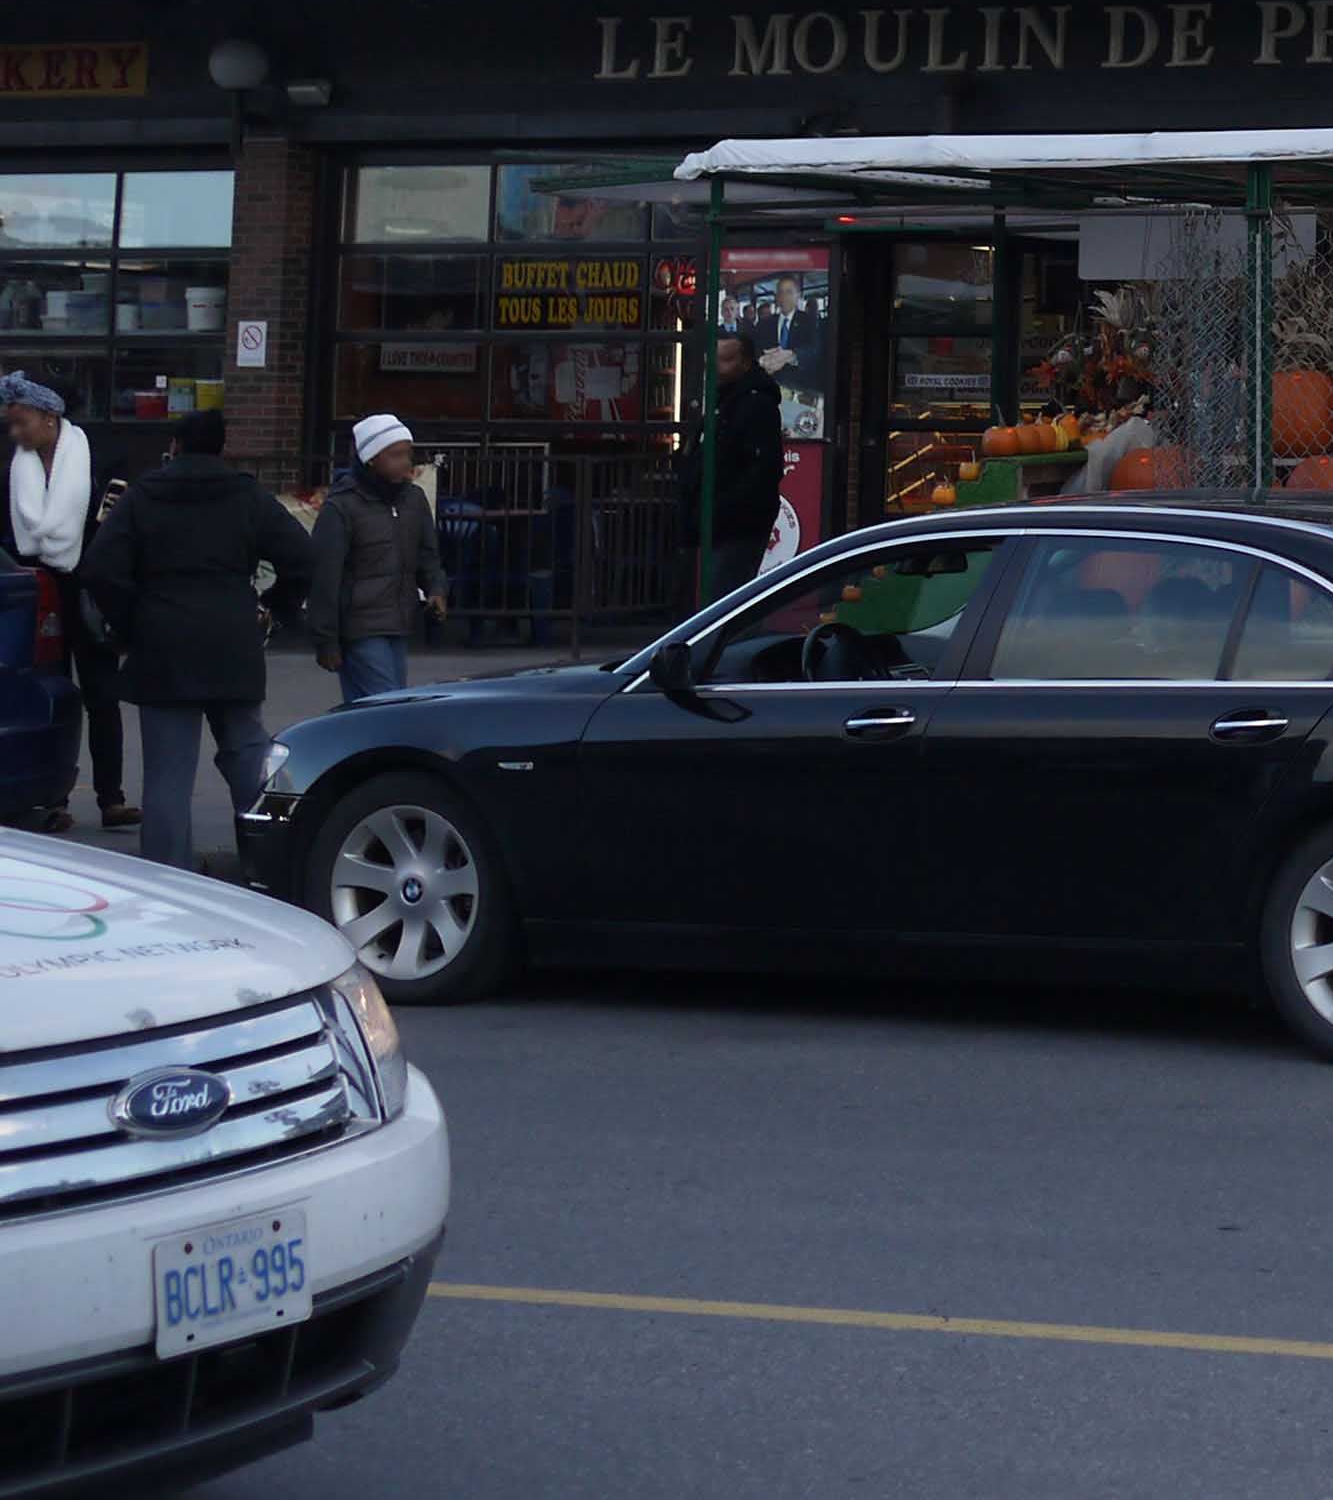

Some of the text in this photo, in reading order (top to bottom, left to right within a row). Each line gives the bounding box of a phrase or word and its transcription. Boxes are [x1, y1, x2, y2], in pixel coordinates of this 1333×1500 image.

[594, 15, 693, 80] LE
[728, 5, 1073, 77] MOULIN
[1100, 2, 1215, 69] DE
[503, 262, 568, 288] BUFFET
[576, 261, 639, 288] CHAUD
[499, 296, 639, 324] TOUS LES JOURS
[118, 938, 257, 959] NETWORK
[150, 1078, 212, 1117] Ford
[202, 1228, 264, 1255] ONTARIO
